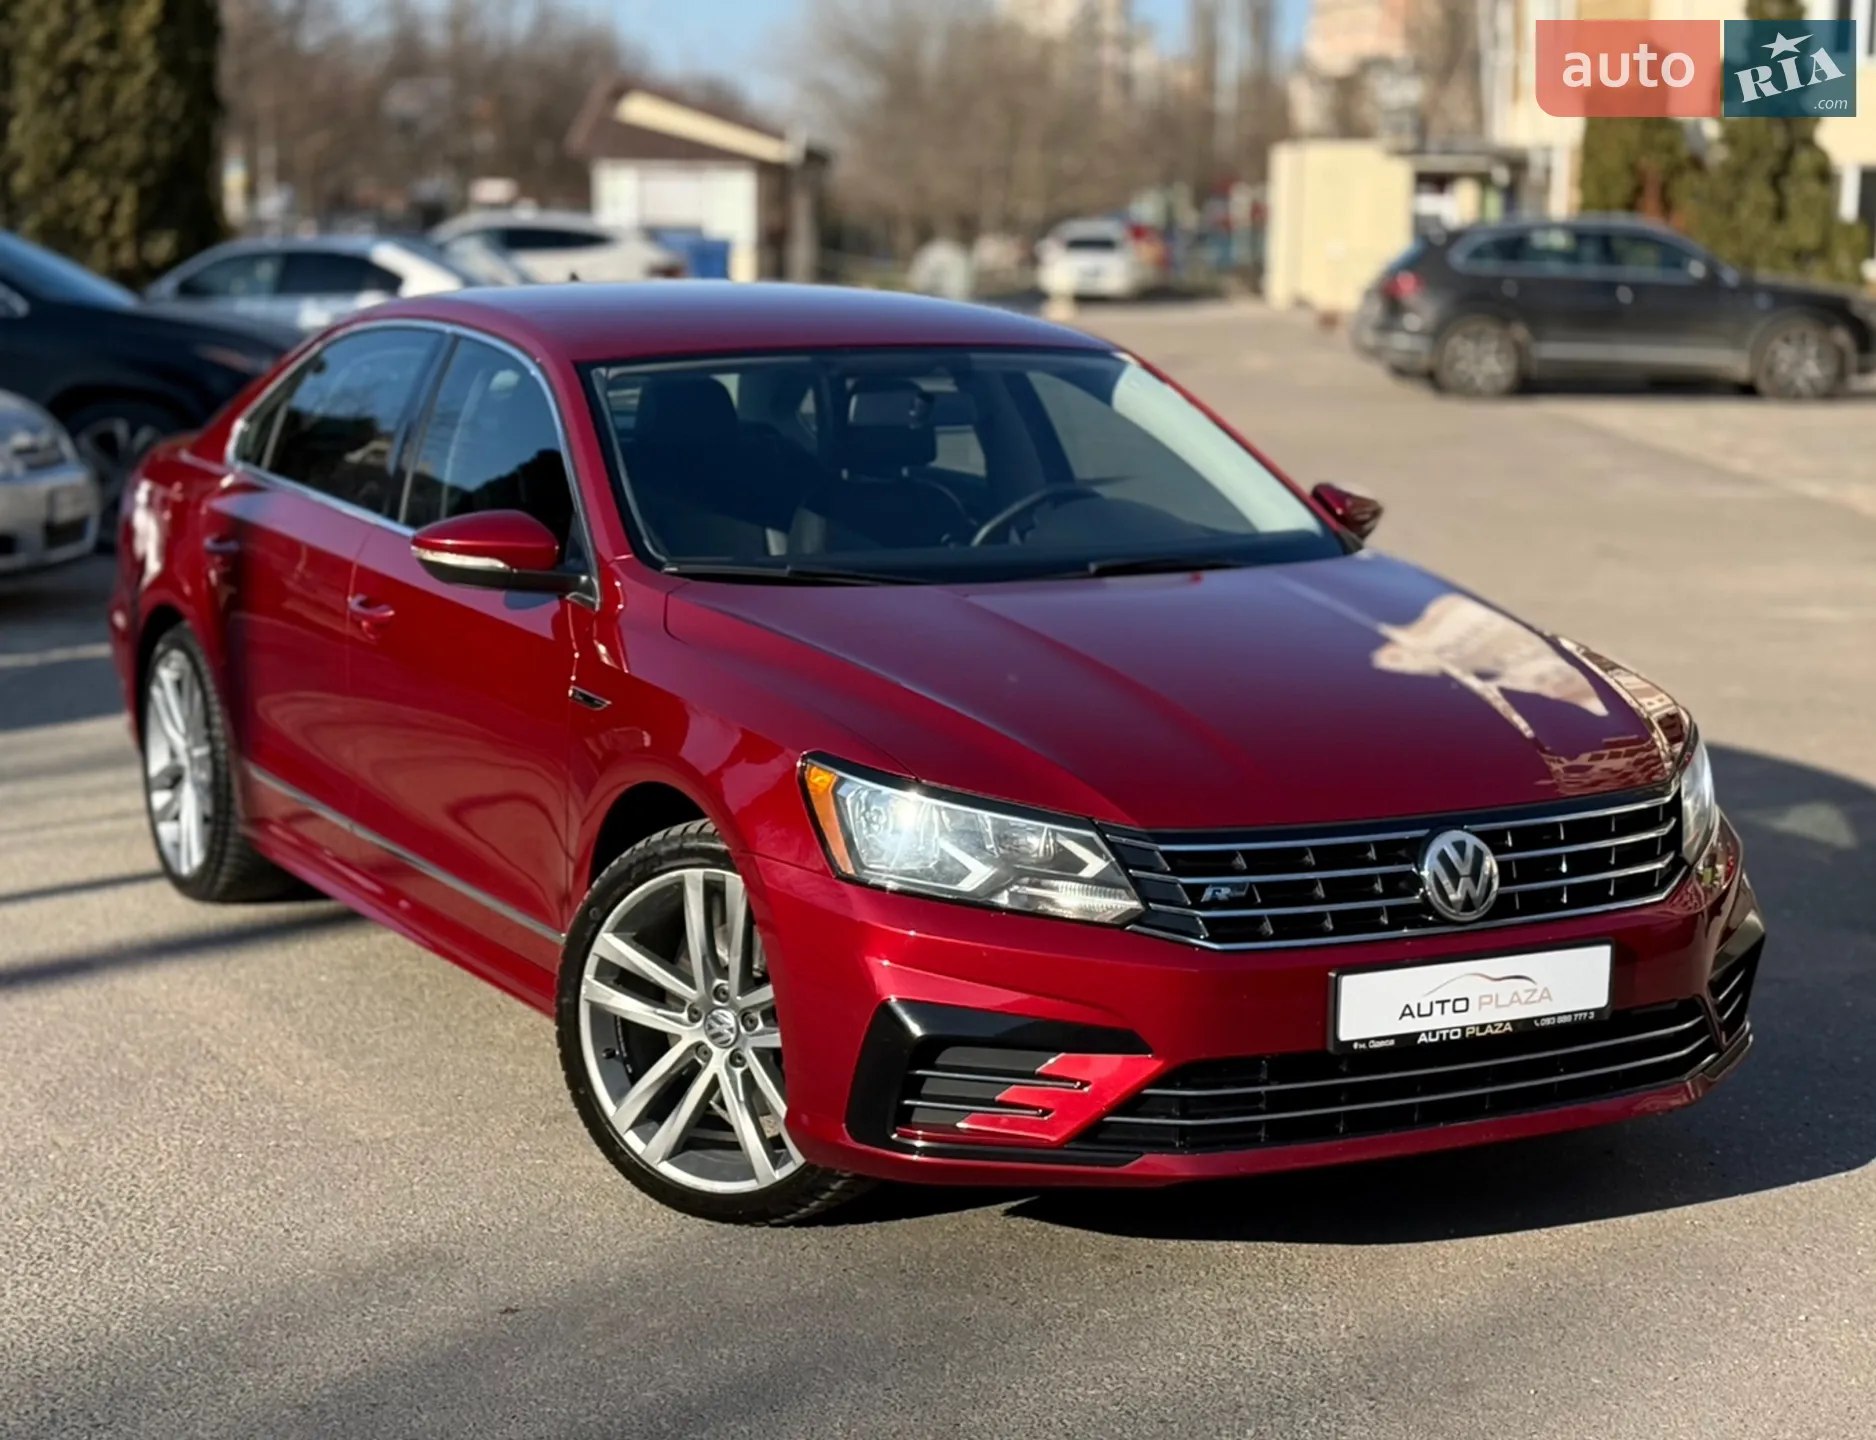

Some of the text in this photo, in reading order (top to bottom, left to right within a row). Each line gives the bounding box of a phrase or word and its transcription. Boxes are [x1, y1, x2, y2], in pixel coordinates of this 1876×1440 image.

[1398, 987, 1553, 1020] AUTO PLAZA
[1417, 1022, 1513, 1044] AUTO PLAZA
